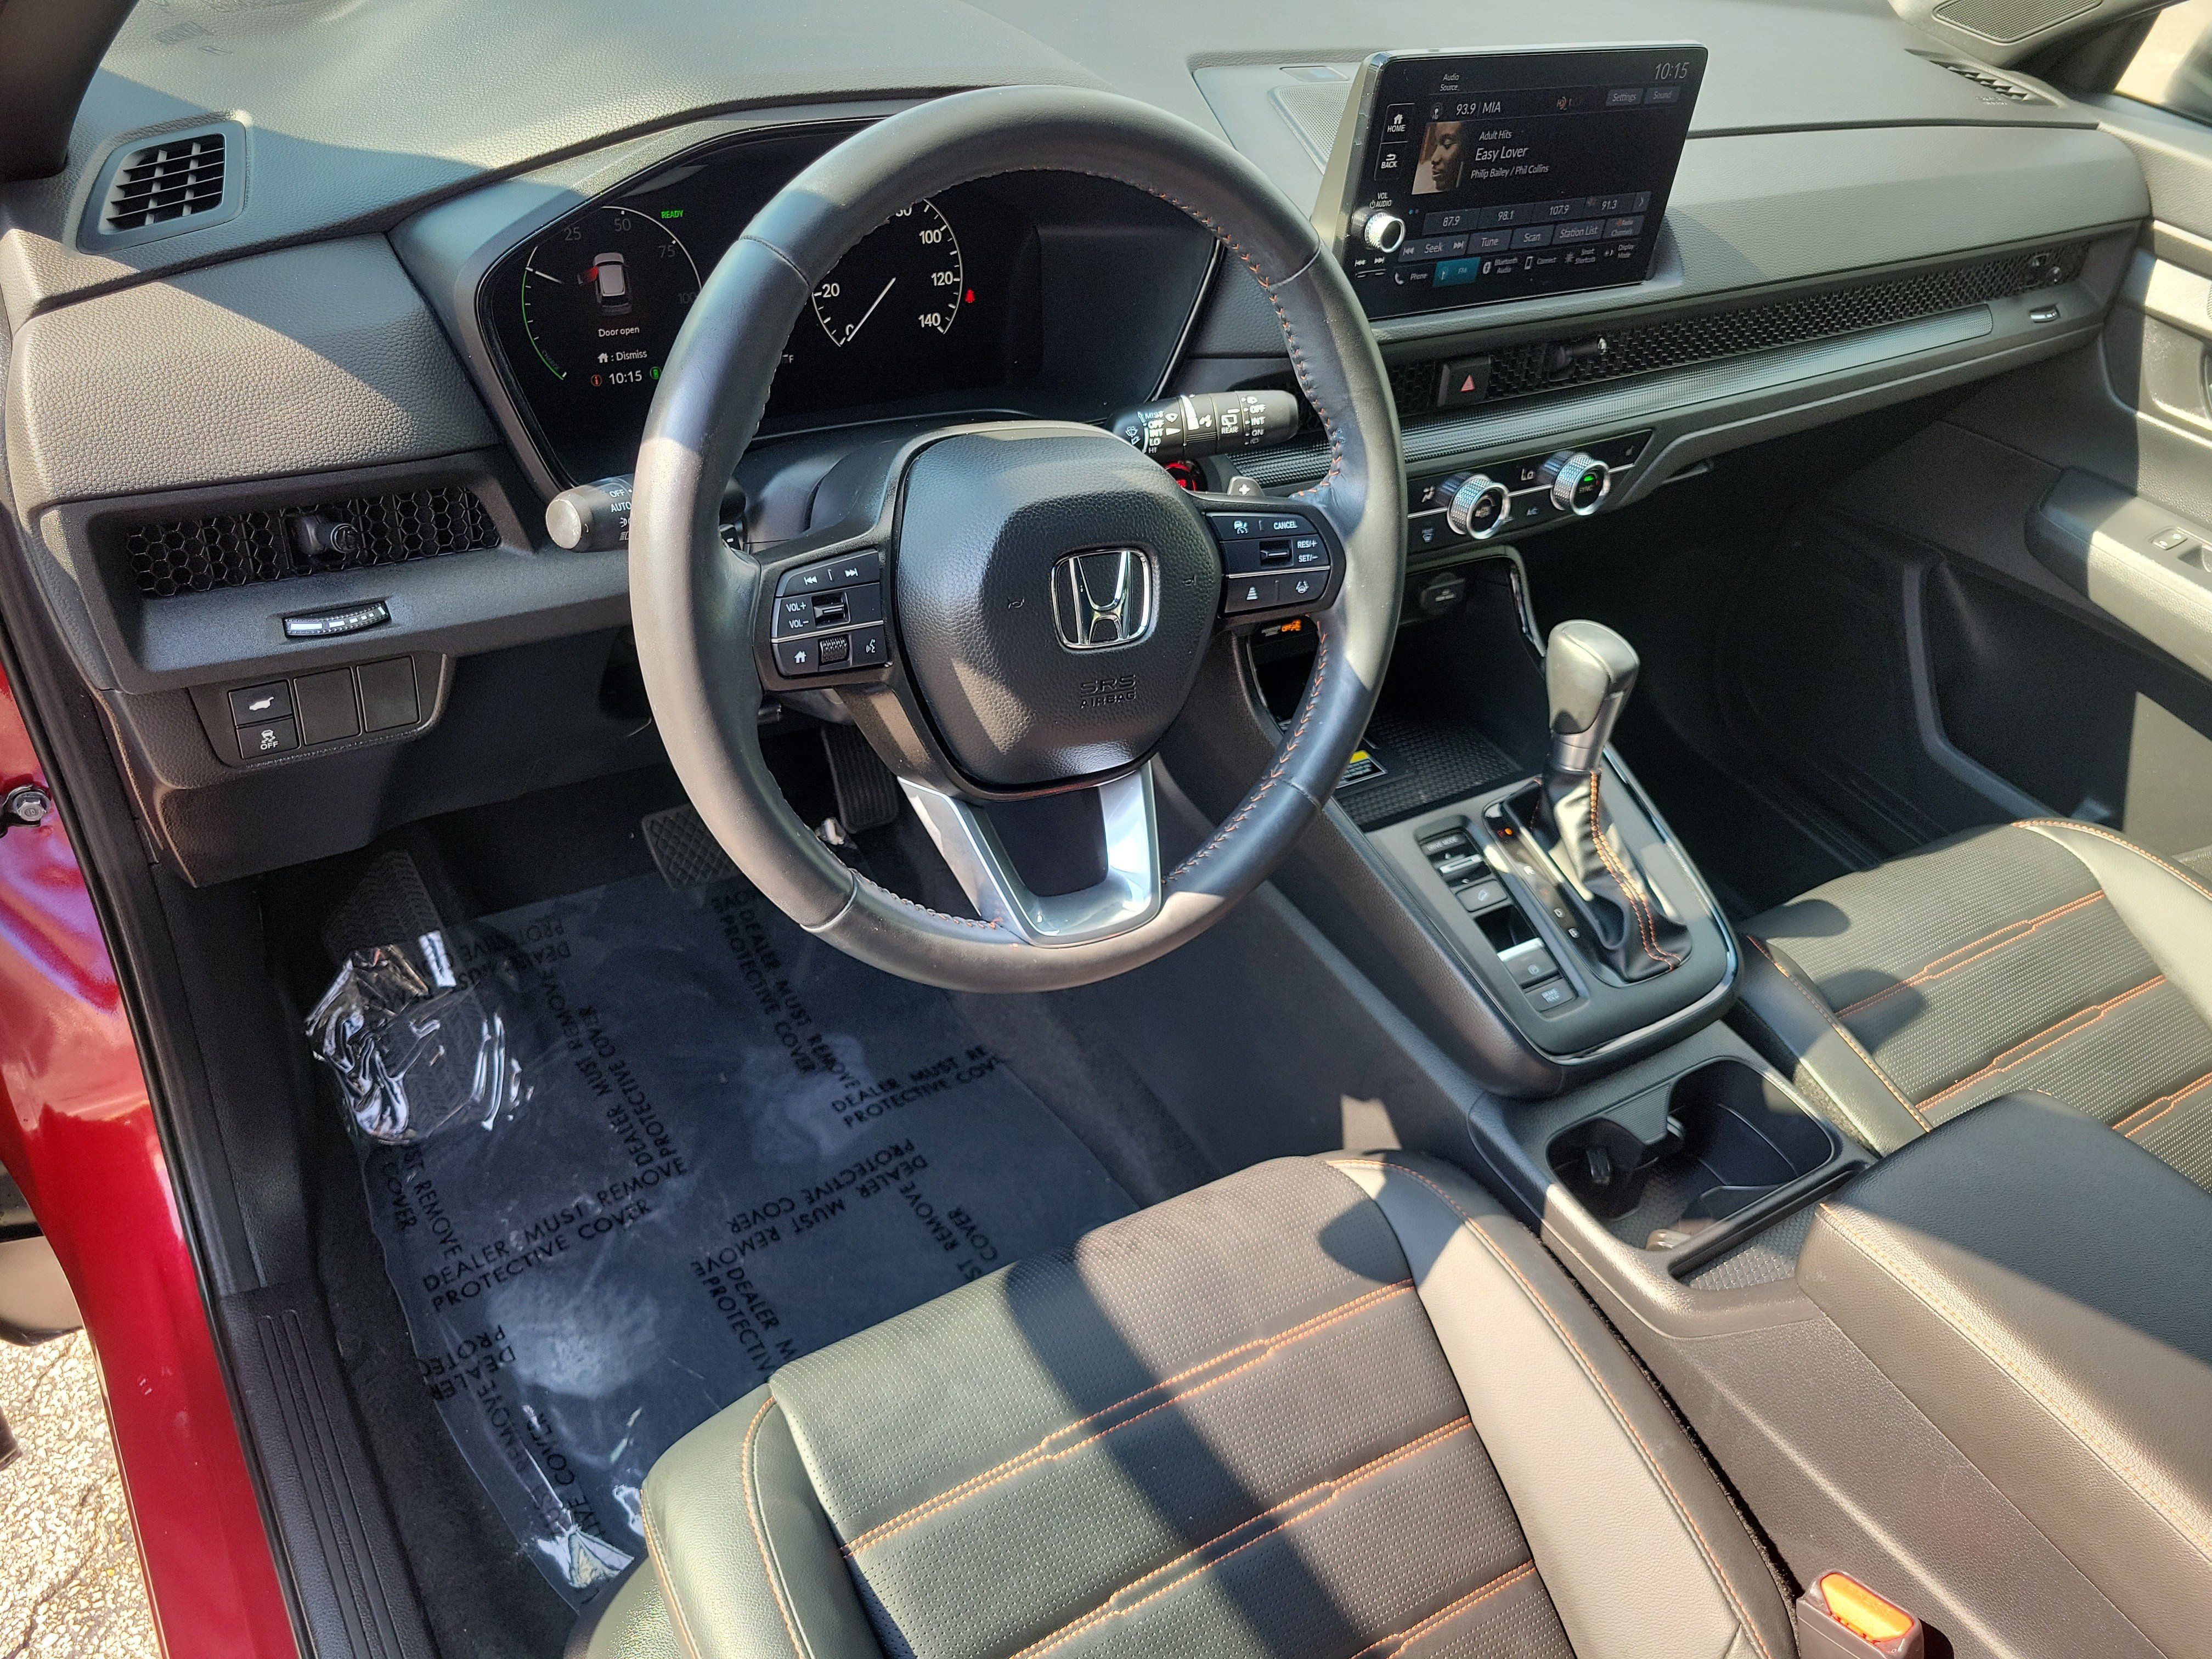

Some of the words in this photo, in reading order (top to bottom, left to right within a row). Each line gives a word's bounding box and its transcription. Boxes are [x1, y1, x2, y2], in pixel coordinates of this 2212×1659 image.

[1443, 73, 1459, 81] Audio
[1655, 62, 1689, 80] 10:15
[1612, 93, 1636, 103] Settings
[1457, 103, 1476, 115] 93.9
[1482, 101, 1501, 114] MIA
[1387, 125, 1406, 133] HOME
[1479, 131, 1498, 141] Adult
[1498, 130, 1513, 139] Hits
[1475, 148, 1499, 162] Easy
[1500, 146, 1528, 159] Lover
[1381, 161, 1398, 169] BACK
[1471, 169, 1488, 179] Philip
[1490, 168, 1509, 178] Bailey
[1515, 166, 1527, 175] Phil
[1528, 164, 1549, 174] Collins
[1549, 205, 1569, 216] 107.9
[1601, 200, 1617, 210] 91.3
[661, 210, 684, 219] READY
[1498, 210, 1515, 221] 98.1
[614, 219, 631, 232] 50
[1442, 216, 1460, 227] 87.9
[564, 227, 582, 241] 25
[919, 229, 941, 244] 100
[1523, 233, 1541, 242] Scan
[1559, 228, 1584, 239] Station
[1585, 226, 1598, 235] List
[1424, 243, 1442, 253] Seek
[1481, 238, 1499, 247] Tune
[659, 245, 676, 258] 75
[932, 271, 953, 286] 120
[822, 283, 840, 297] 20
[918, 313, 941, 328] 140
[598, 328, 618, 337] Door
[620, 326, 640, 336] open
[616, 350, 647, 361] Dismiss
[609, 371, 642, 385] 10:15
[1144, 410, 1164, 420] MIST
[1250, 404, 1266, 414] OFF
[1148, 419, 1165, 430] OFF
[1251, 416, 1265, 426] INT
[1252, 428, 1265, 437] ON
[1149, 437, 1161, 447] LO
[610, 488, 625, 498] OFF
[611, 501, 631, 512] AUTO
[1274, 521, 1298, 530] CANCEL
[1297, 540, 1318, 549] RES/+
[786, 602, 806, 612] VOL+
[789, 620, 809, 629] VOL-
[1080, 674, 1137, 692] SRS
[1080, 691, 1137, 709] AIRBAG
[260, 741, 279, 751] OFF
[773, 979, 814, 1028] MUST
[773, 1020, 816, 1074] COVER
[575, 1056, 614, 1097] MUST
[831, 1077, 901, 1113] DEALER
[909, 1055, 959, 1082] MUST
[608, 1059, 678, 1159] PROTECTIVE
[843, 1077, 952, 1128] PROTECTIVE
[606, 1103, 654, 1168] DEALER
[800, 1137, 916, 1206] PROTECTIVE
[855, 1154, 930, 1200] DEALER
[383, 1160, 419, 1231] COVER
[414, 1178, 464, 1261] REMOVE
[726, 1196, 797, 1235] COVER
[790, 1195, 847, 1235] MUST
[898, 1179, 961, 1254] REMOVE
[422, 1239, 511, 1294] DEALER
[524, 1203, 585, 1249] MUST
[596, 1155, 689, 1208] REMOVE
[947, 1205, 1000, 1262] COVER
[431, 1233, 571, 1313] PROTECTIVE
[577, 1198, 653, 1242] COVER
[689, 1224, 782, 1280] REMOVE
[726, 1266, 781, 1331] DEALER
